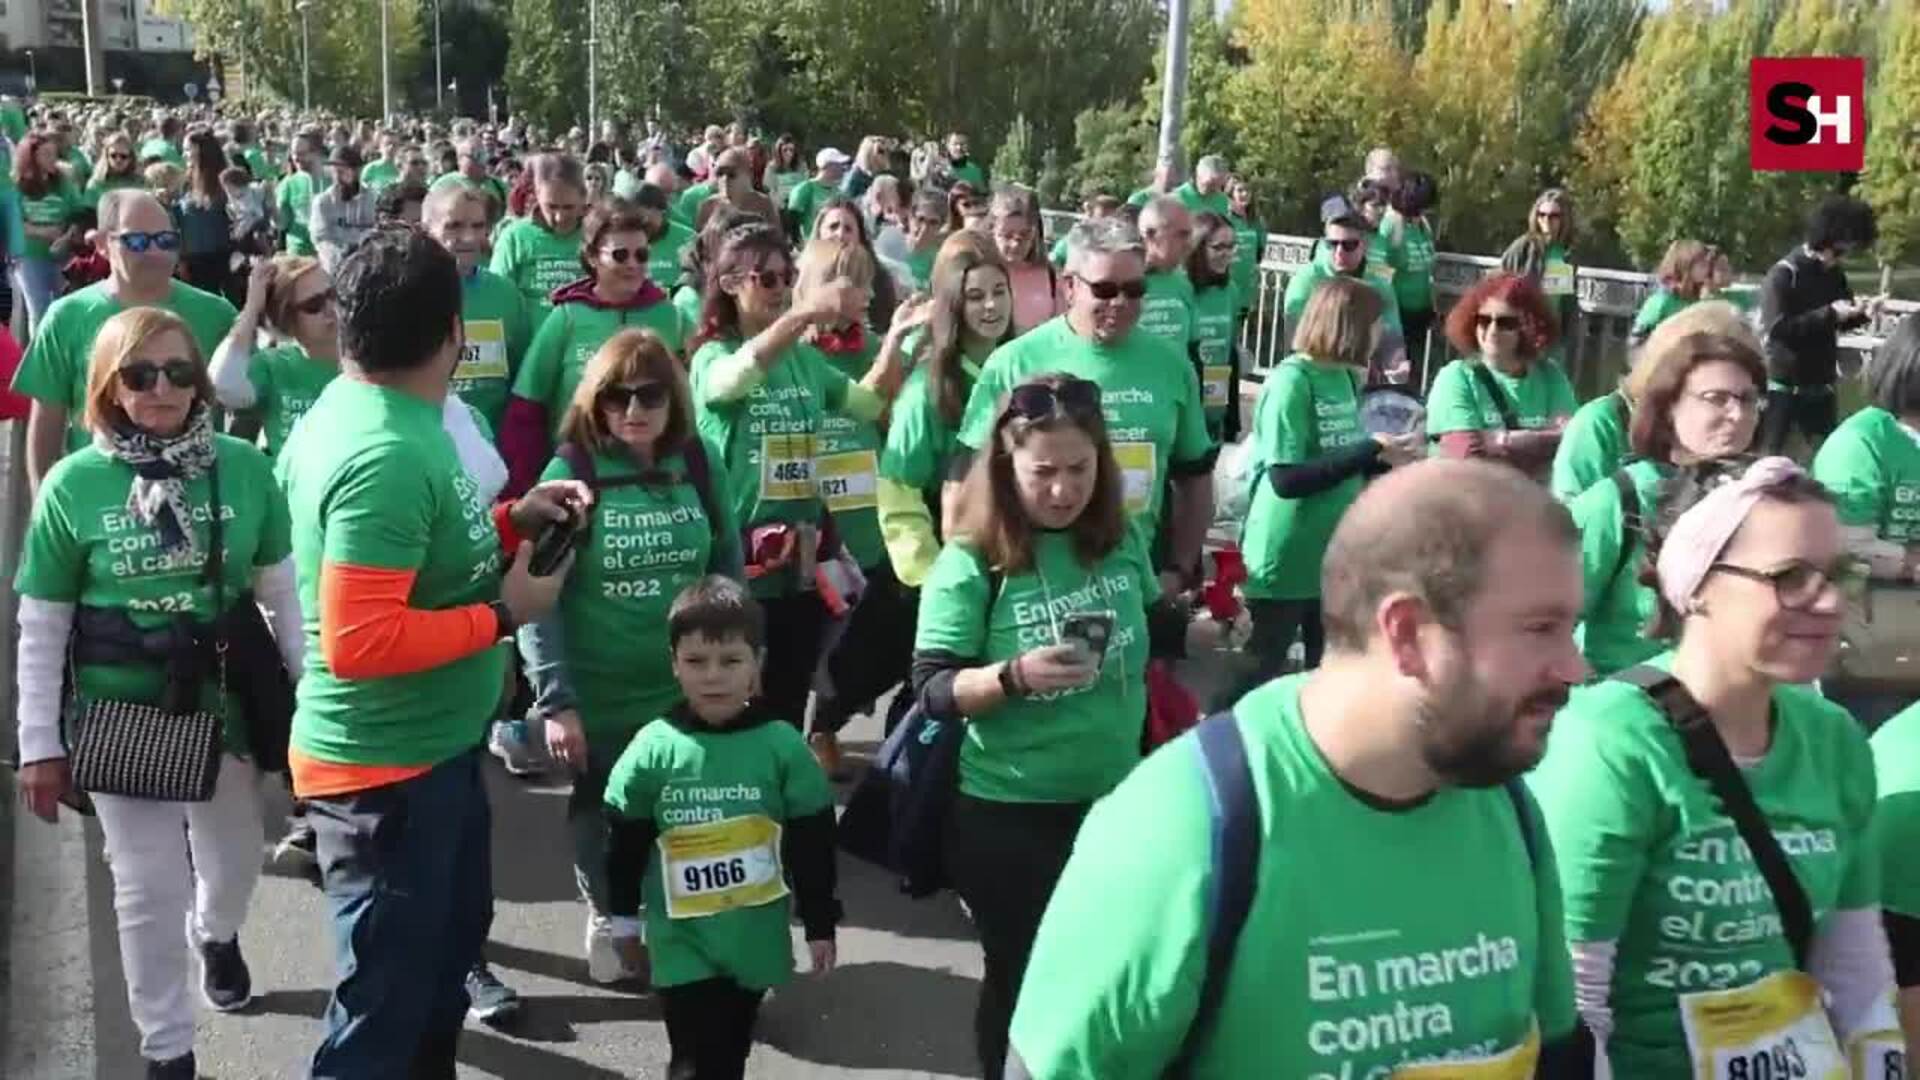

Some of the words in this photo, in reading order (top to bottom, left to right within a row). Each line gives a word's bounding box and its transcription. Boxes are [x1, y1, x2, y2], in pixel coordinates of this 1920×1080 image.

[604, 509, 629, 528] En
[604, 530, 673, 550] contra
[111, 554, 137, 576] el
[604, 555, 624, 570] el
[602, 578, 662, 597] 2022
[660, 786, 684, 801] En
[689, 783, 762, 801] marcha
[662, 806, 724, 823] contra
[684, 857, 746, 892] 9166
[1660, 911, 1705, 941] el
[1308, 954, 1367, 1001] En
[1374, 931, 1519, 994] marcha
[1308, 1000, 1453, 1055] contra
